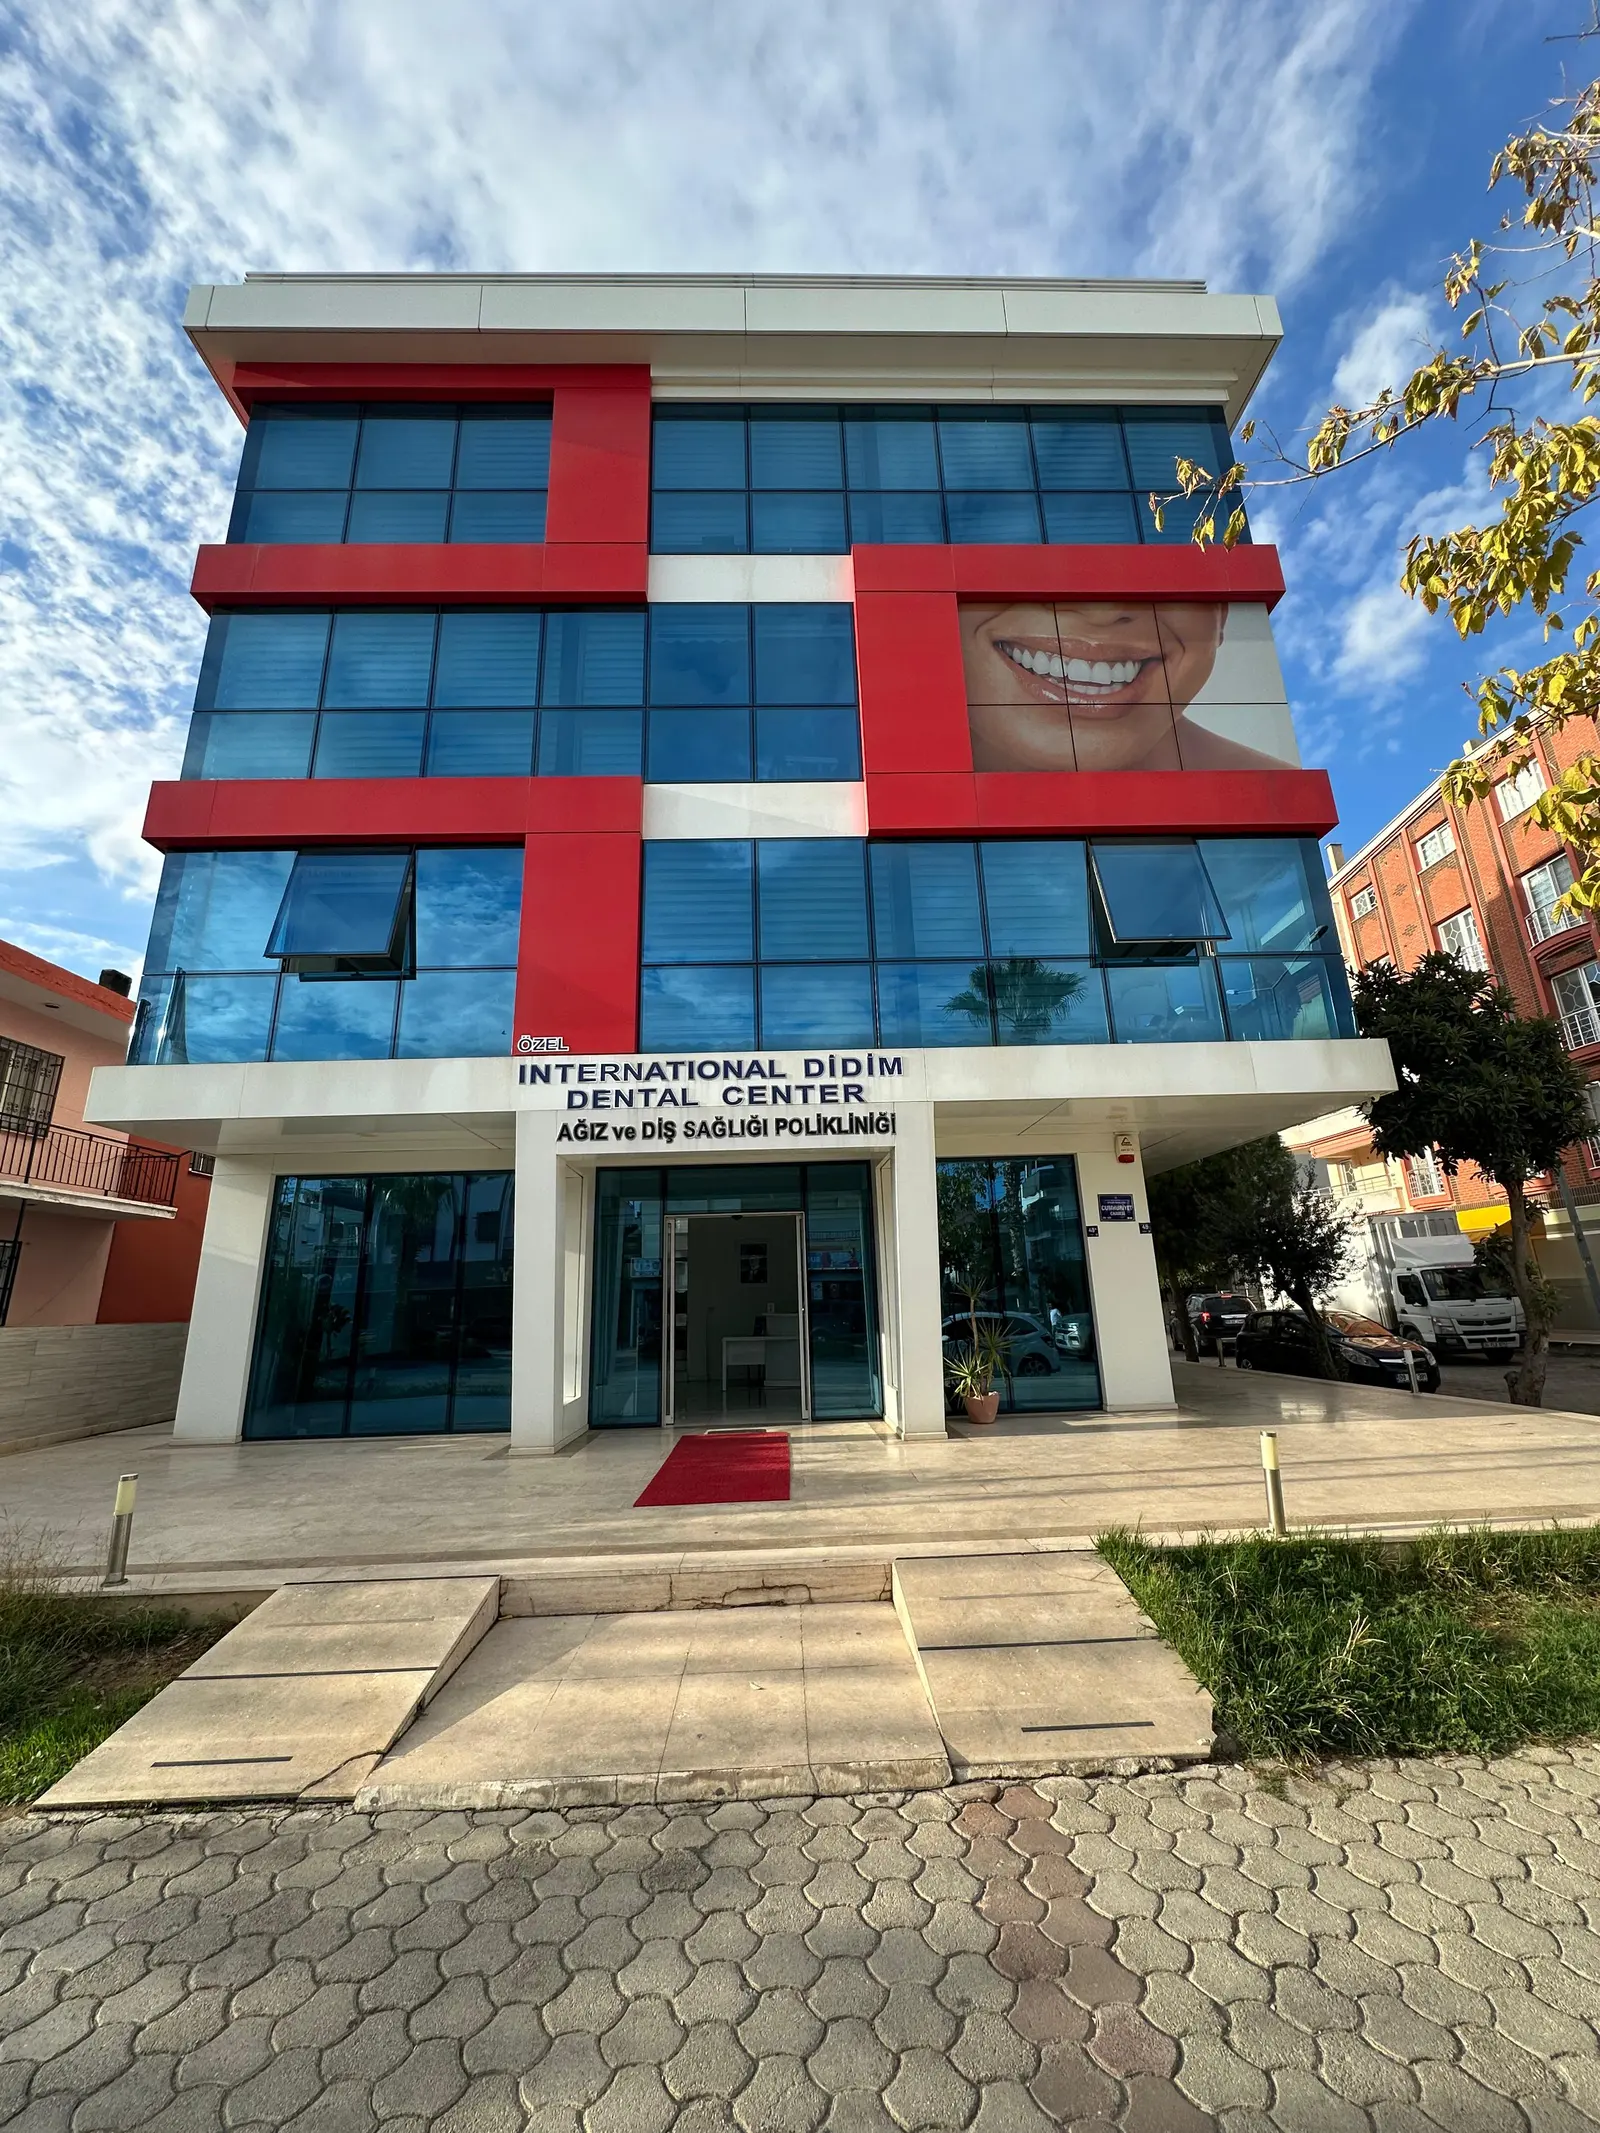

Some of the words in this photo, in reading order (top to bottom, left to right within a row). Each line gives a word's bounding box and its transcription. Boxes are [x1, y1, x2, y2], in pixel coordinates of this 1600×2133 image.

[517, 1035, 569, 1053] ÖZEL
[518, 1058, 787, 1085] INTERNATIONAL
[804, 1052, 903, 1079] DİDİM
[566, 1086, 699, 1109] DENTAL
[722, 1082, 865, 1106] CENTER
[556, 1118, 609, 1142] AĞIZ
[612, 1125, 637, 1140] ve
[641, 1116, 677, 1144] DİŞ
[683, 1114, 769, 1139] SAĞLIĞI
[774, 1111, 897, 1137] POLİKLİNİĞİ
